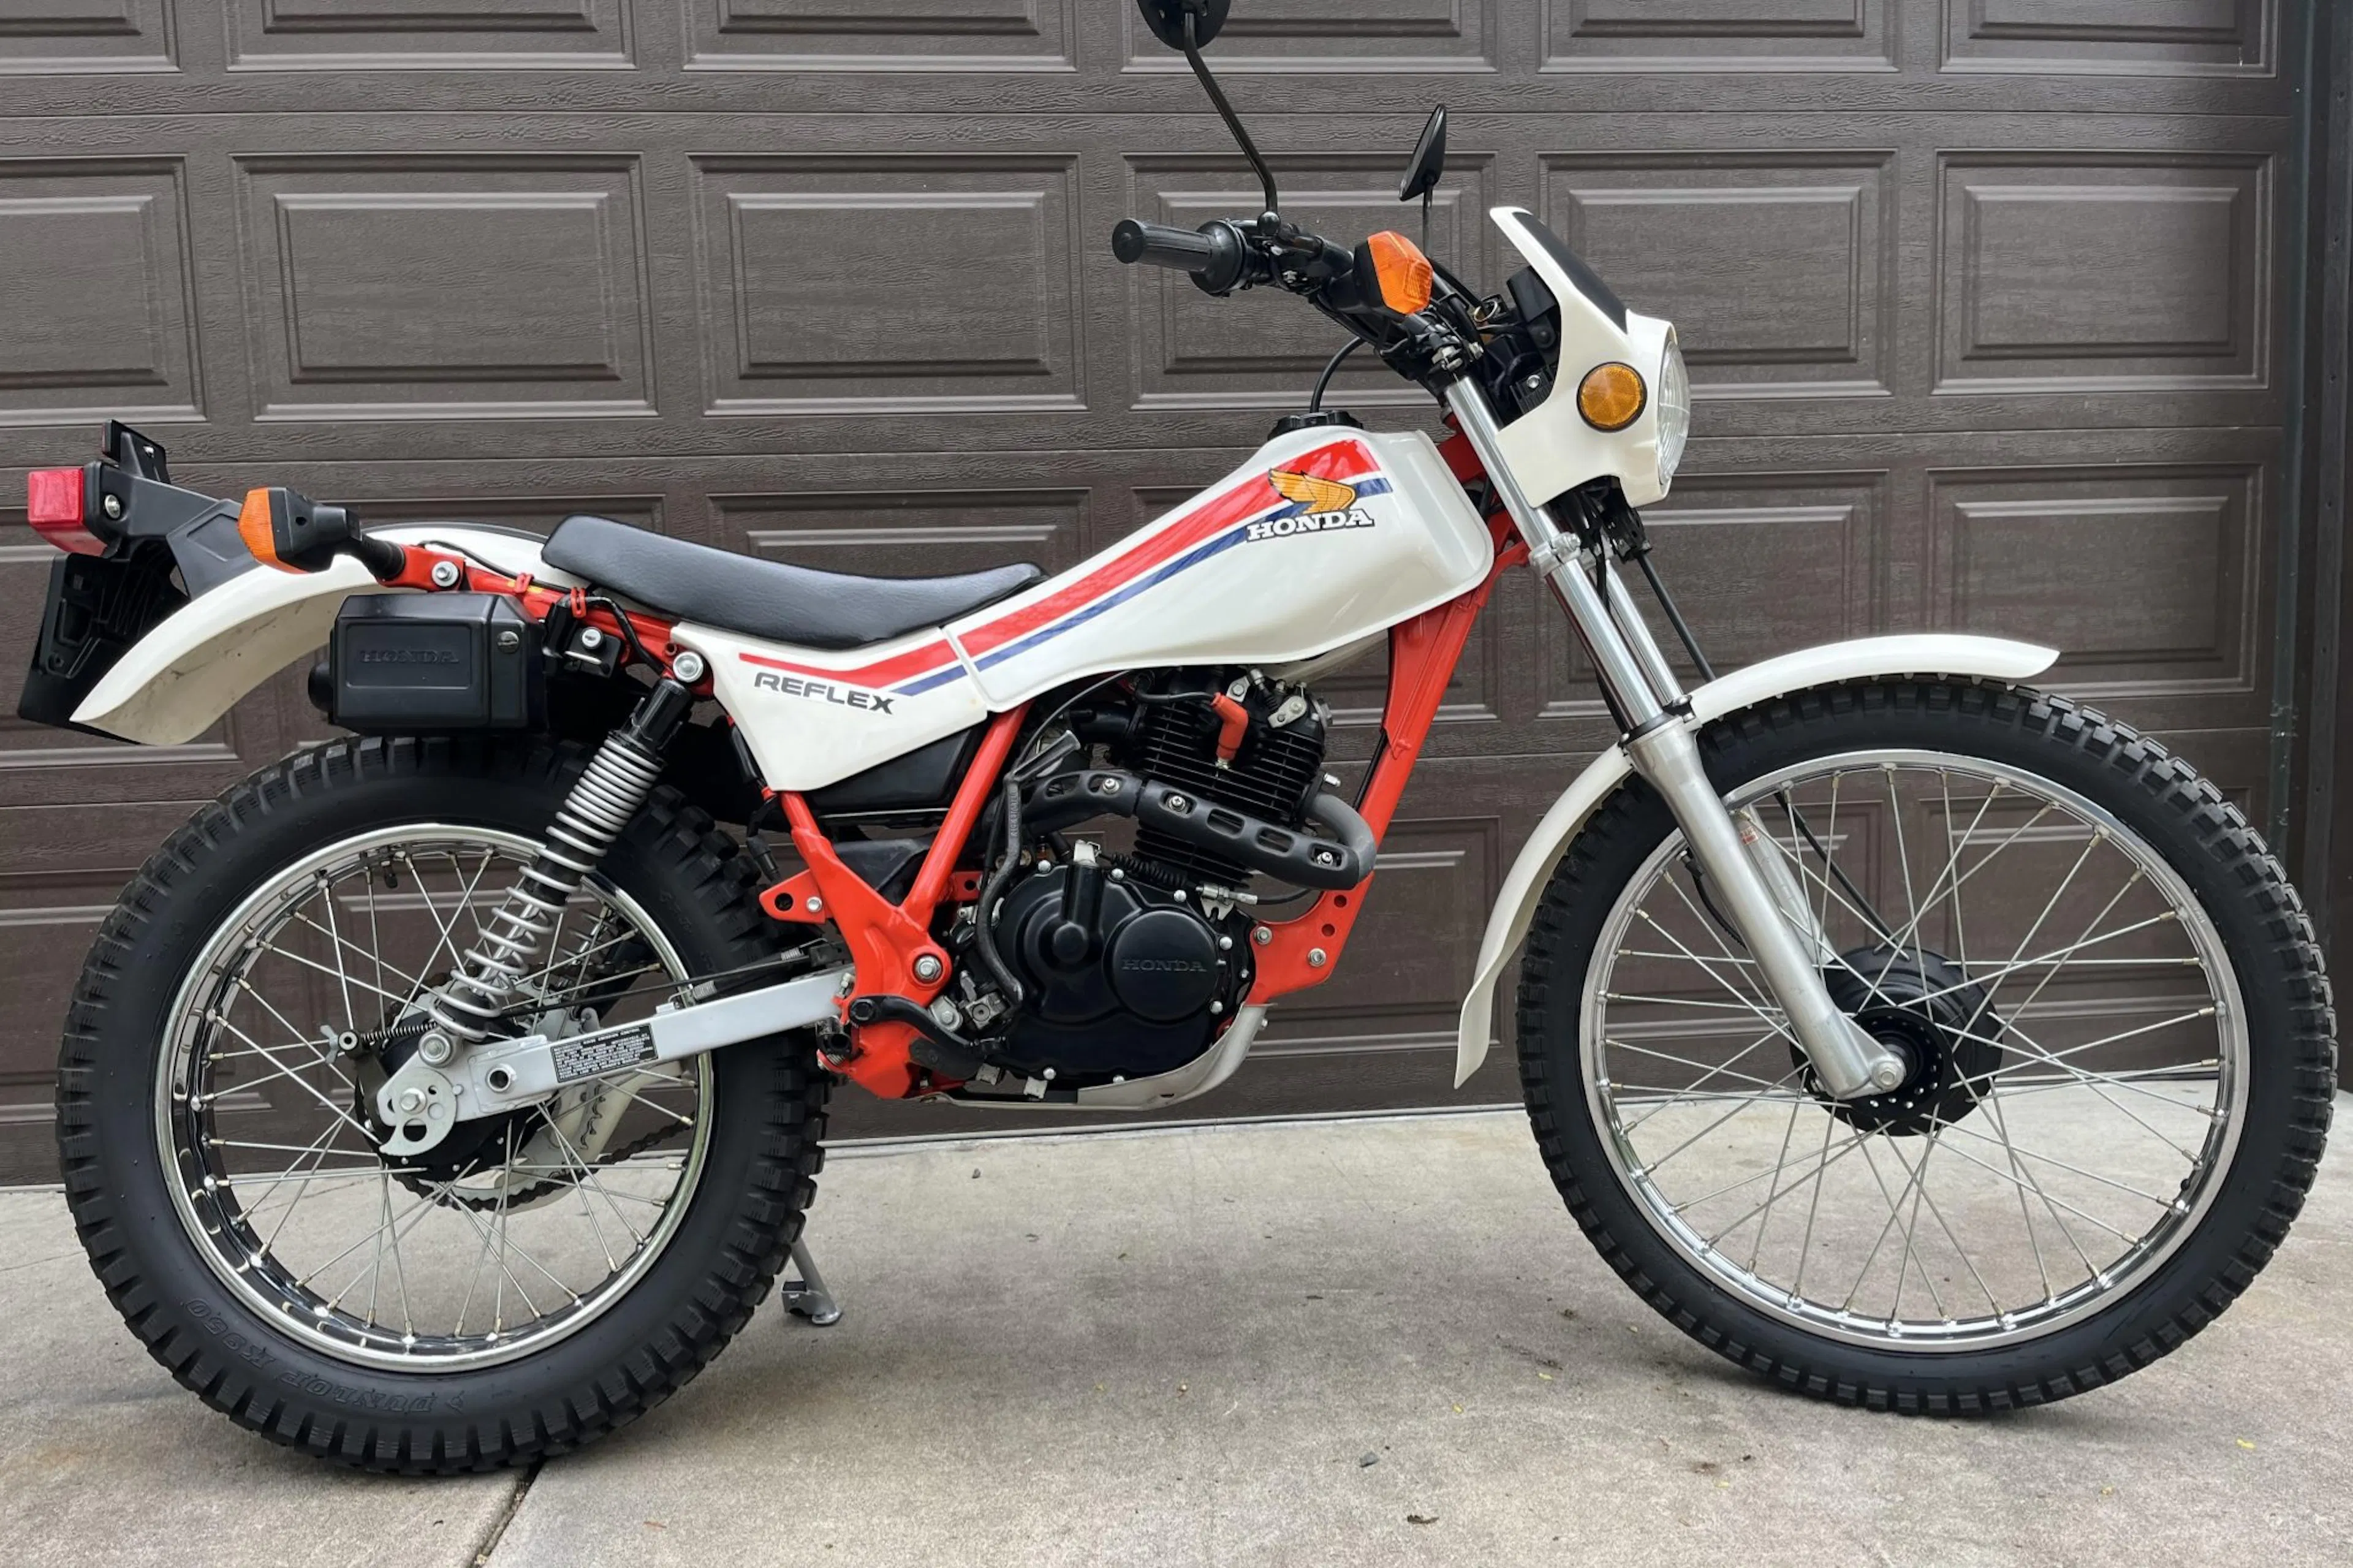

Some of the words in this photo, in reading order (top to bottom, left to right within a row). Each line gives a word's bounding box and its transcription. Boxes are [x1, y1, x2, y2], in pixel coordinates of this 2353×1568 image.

[1246, 507, 1374, 542] HONDA
[359, 650, 460, 664] HONDA
[754, 672, 895, 715] REFLEX
[1121, 958, 1208, 973] HONDA
[186, 1297, 278, 1370] K950
[279, 1369, 439, 1413] DUNLOP
